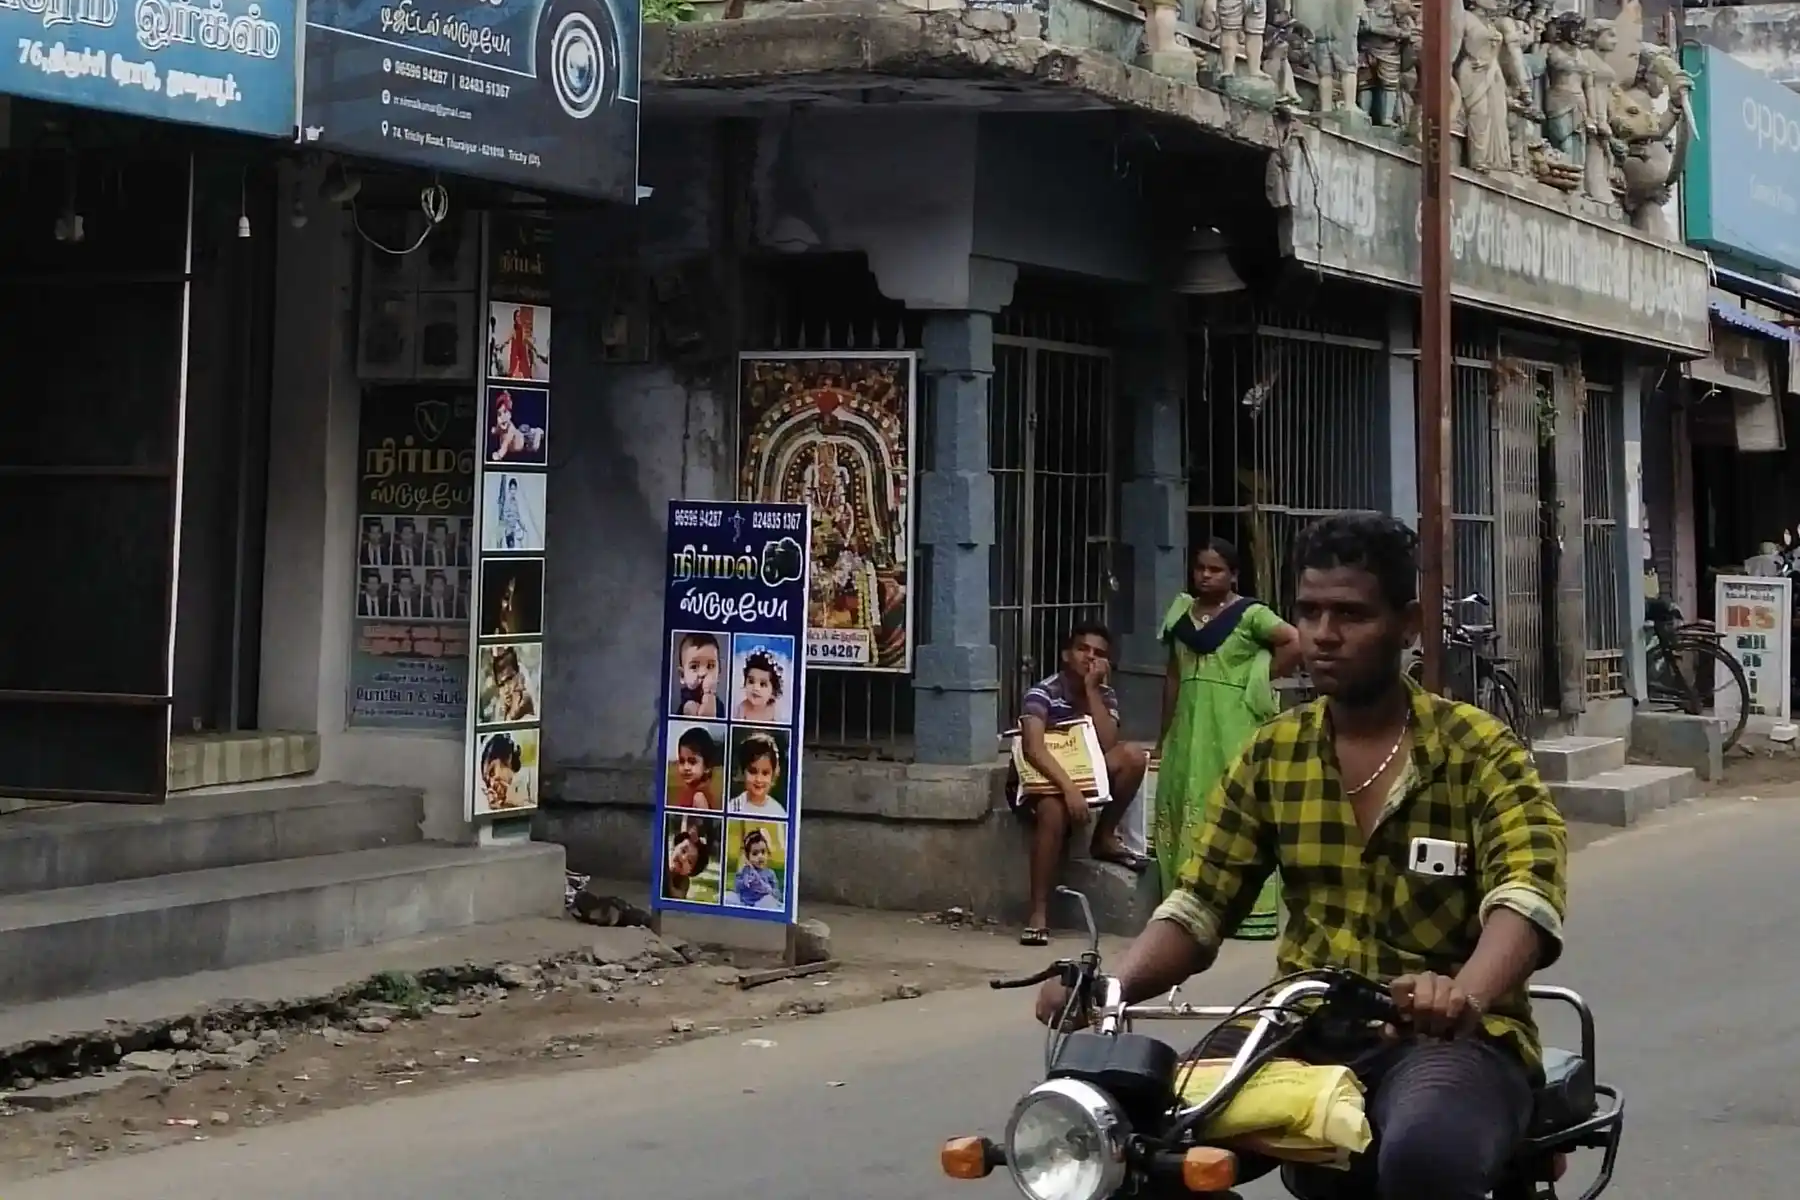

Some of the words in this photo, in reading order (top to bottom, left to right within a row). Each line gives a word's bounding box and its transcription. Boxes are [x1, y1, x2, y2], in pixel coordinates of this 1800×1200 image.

[381, 0, 440, 36] டிஜிட்டல்
[1741, 96, 1800, 154] oppo
[671, 543, 758, 587] நிர்மல்
